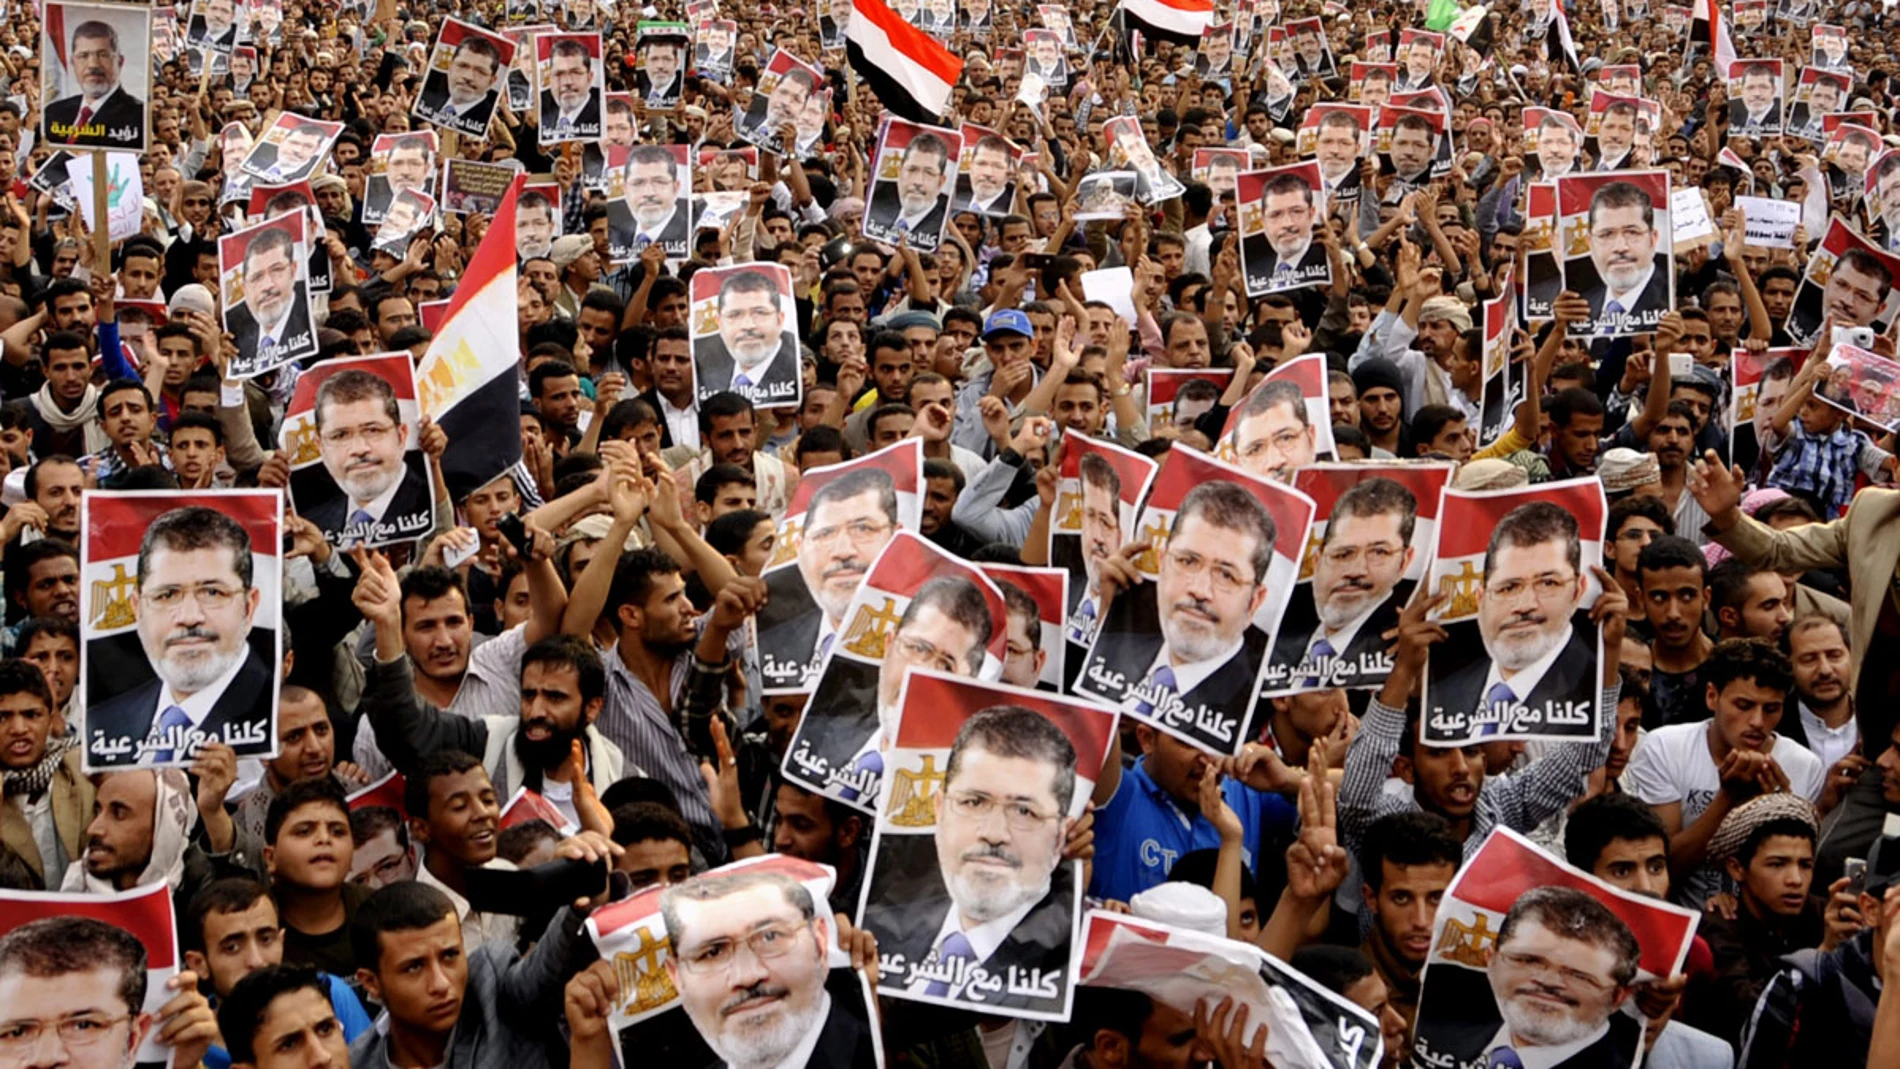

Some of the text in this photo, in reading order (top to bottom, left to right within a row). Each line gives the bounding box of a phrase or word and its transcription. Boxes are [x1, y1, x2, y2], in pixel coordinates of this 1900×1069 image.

[50, 122, 105, 139] الشرعية
[1249, 270, 1293, 289] الشرعية
[1306, 264, 1327, 277] كلنا
[288, 330, 311, 351] كلنا
[769, 381, 796, 399] كلنا
[374, 523, 397, 541] مع
[397, 510, 430, 532] كلنا
[1264, 650, 1395, 686] كلنا مع الشرعي
[1088, 656, 1237, 743] كلنا مع الشرعية
[1429, 698, 1590, 736] كلنا مع الشرعية
[91, 724, 185, 761] الشرعية
[223, 718, 267, 746] كلنا
[878, 950, 1062, 1000] كلنا مع الشرعي
